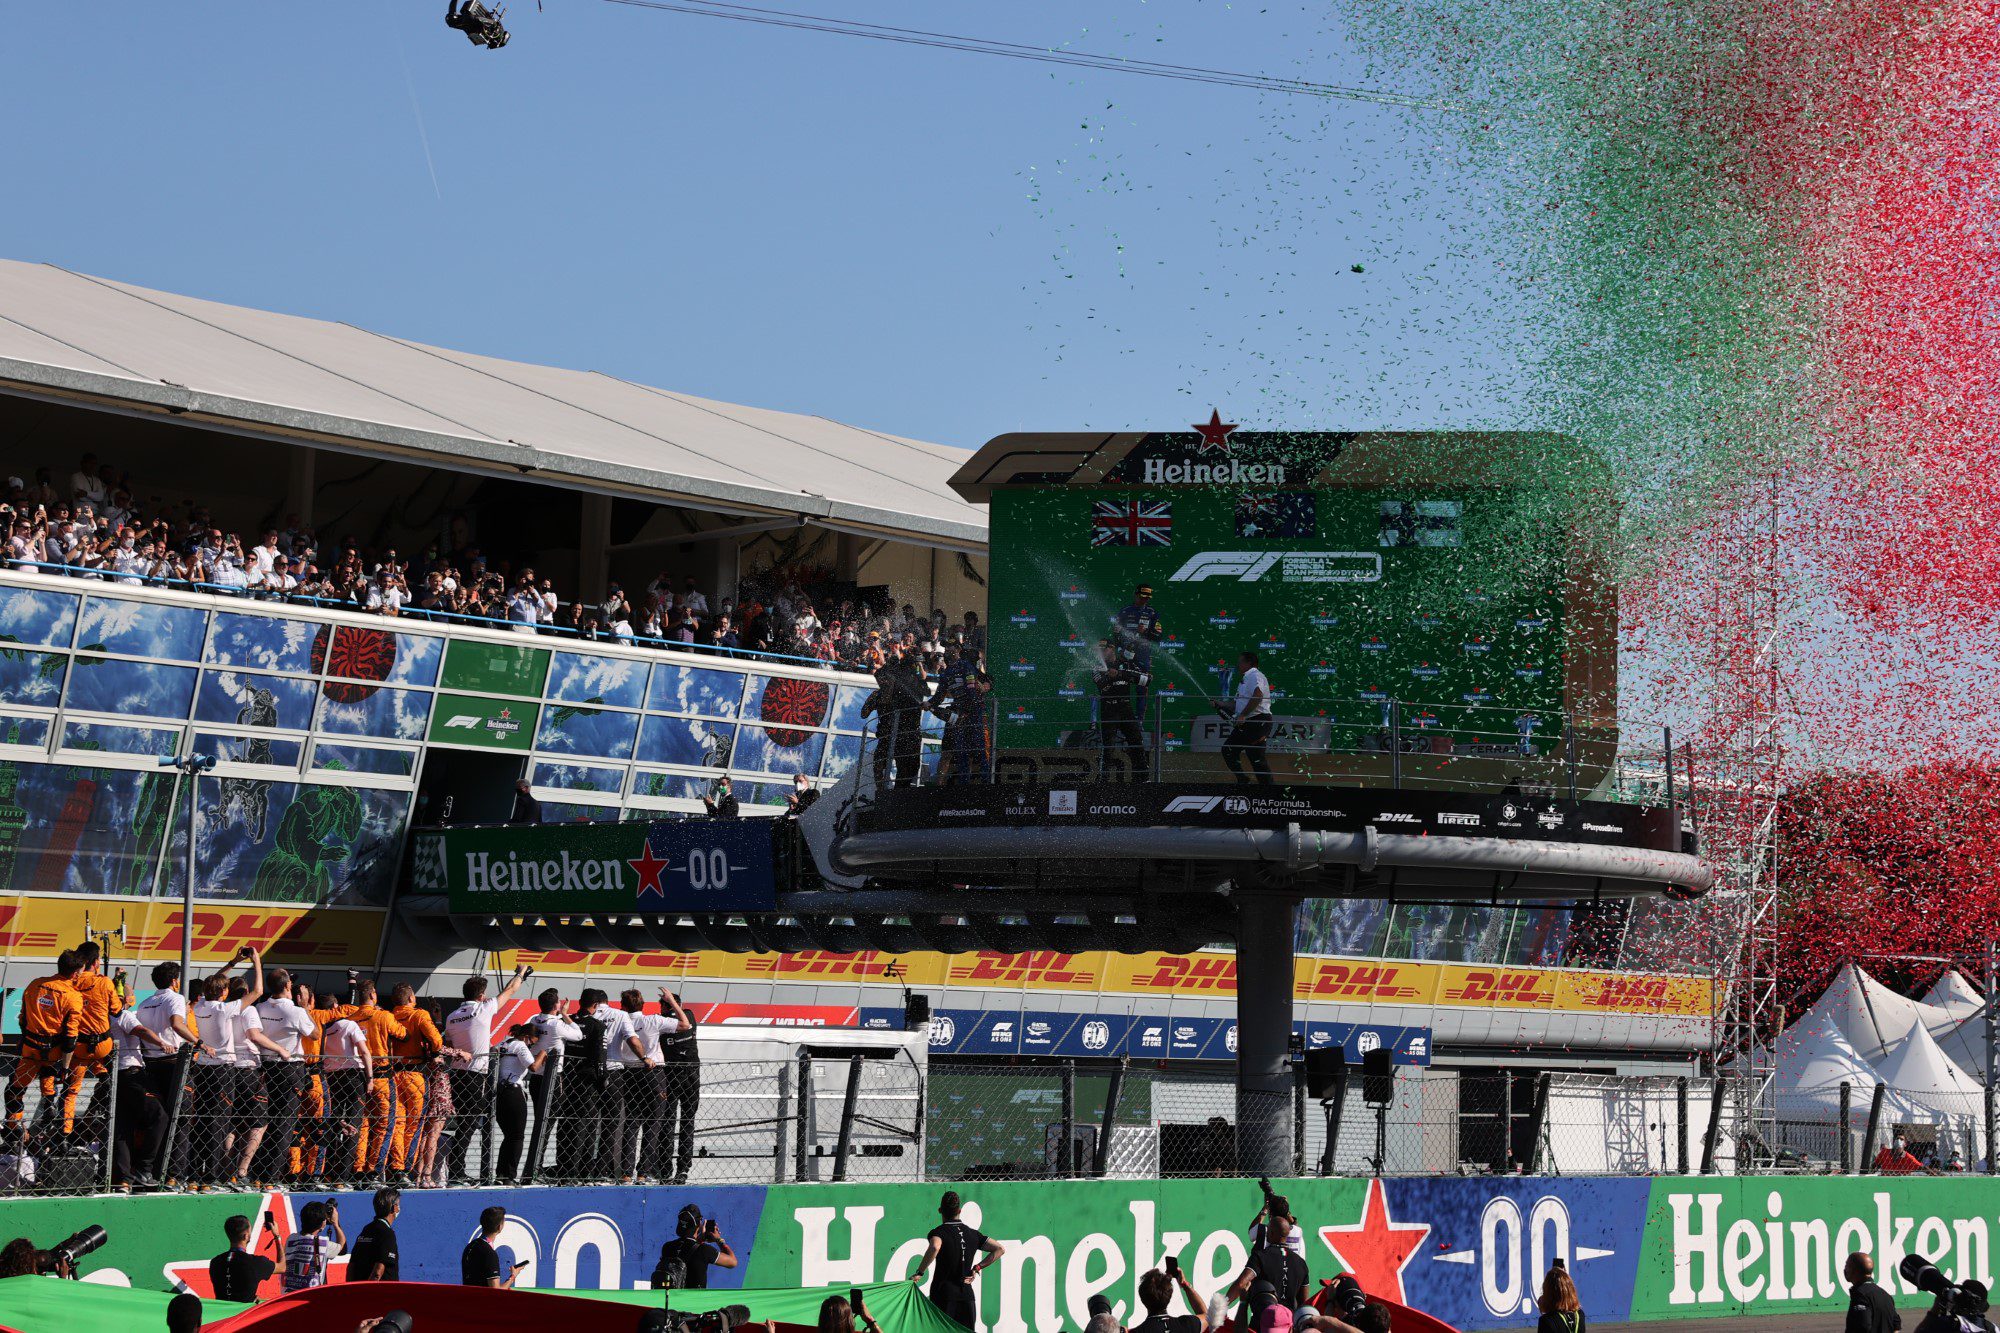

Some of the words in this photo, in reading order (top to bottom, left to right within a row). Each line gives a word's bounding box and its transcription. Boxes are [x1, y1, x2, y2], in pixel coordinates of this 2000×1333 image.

[1143, 458, 1286, 484] Heineken
[486, 719, 520, 731] Heineken
[1204, 723, 1315, 740] FEARI
[1471, 745, 1519, 753] FERRAR
[939, 807, 986, 816] #WeRaceAsOne
[1005, 806, 1036, 815] ROLEX
[1051, 805, 1075, 813] Emirates
[1089, 805, 1137, 815] aramco
[1225, 799, 1248, 811] FIA
[1252, 798, 1267, 807] FIA
[1268, 799, 1305, 808] Formula
[1306, 800, 1311, 808] 1
[1252, 806, 1278, 815] World
[1438, 812, 1480, 825] PIRELLI
[1582, 822, 1623, 834] #PurposeDriven
[465, 850, 625, 892] Heineken
[688, 848, 728, 890] 0.0
[155, 911, 317, 955] DHL
[769, 949, 894, 975] DHL
[968, 950, 1076, 983] DHL
[1150, 956, 1237, 988] DHL
[1313, 964, 1400, 997] DHL
[1460, 972, 1542, 1002] DHL
[1596, 978, 1669, 1008] DHL
[1479, 1194, 1570, 1318] 0.0
[1668, 1190, 1994, 1305] Heineken
